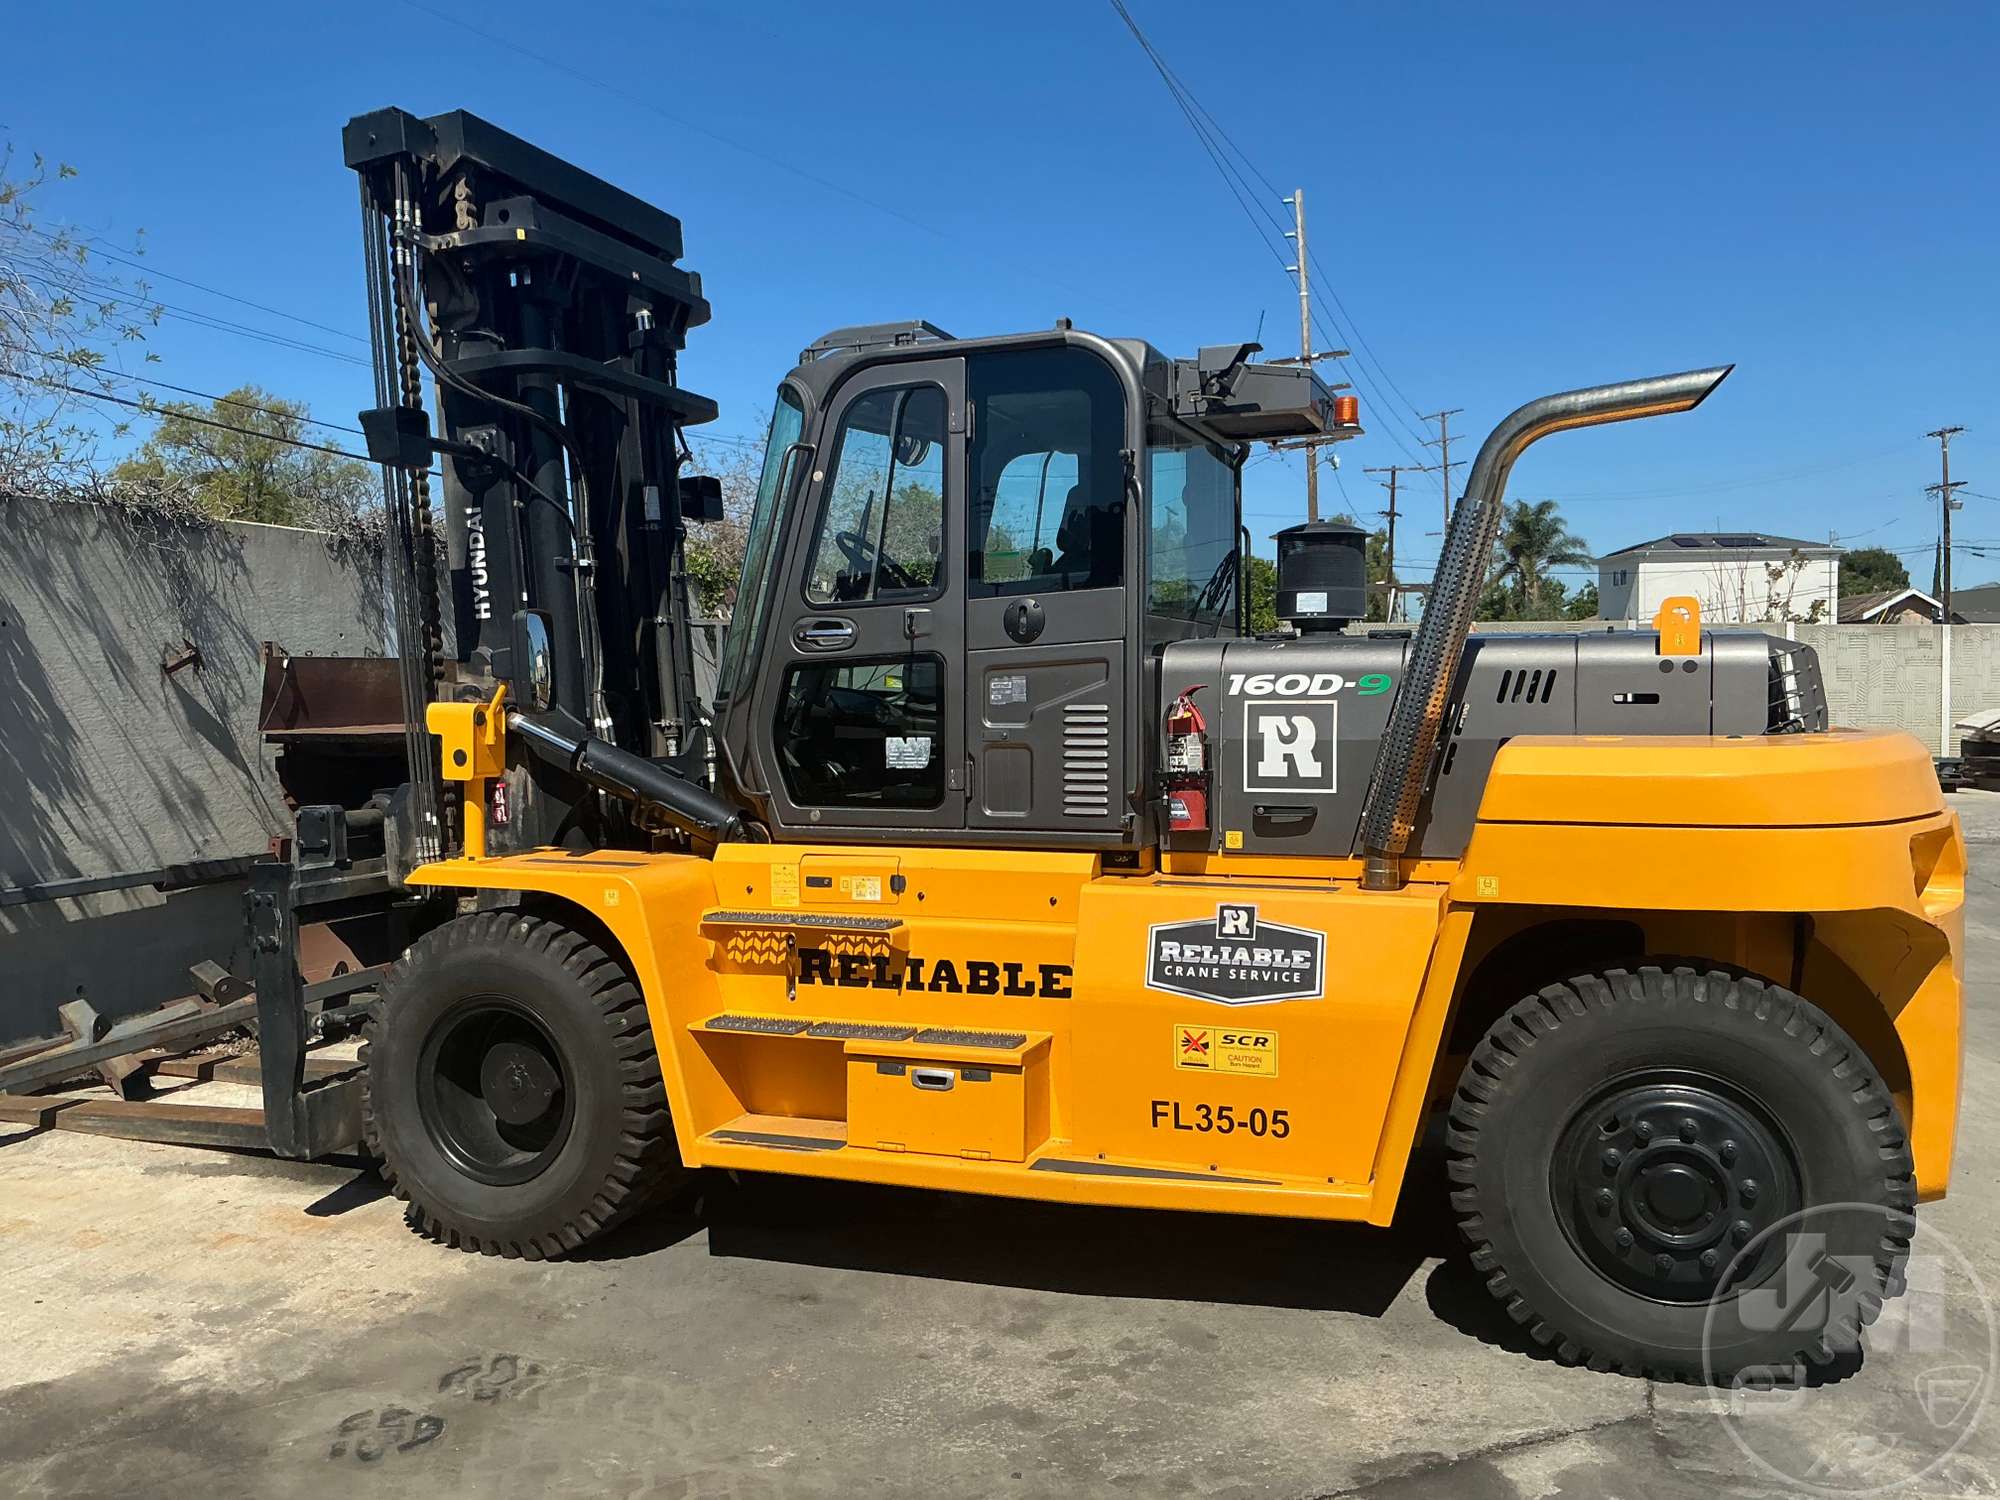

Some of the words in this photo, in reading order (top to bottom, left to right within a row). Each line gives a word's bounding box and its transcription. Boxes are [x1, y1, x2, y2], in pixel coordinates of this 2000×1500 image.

[466, 507, 491, 620] HYUNDAI
[1228, 673, 1392, 696] 160D-9
[1257, 715, 1322, 777] R
[1222, 909, 1250, 935] R
[1159, 941, 1312, 969] RELIABLE
[797, 948, 1073, 999] RELIABLE
[1164, 965, 1220, 979] CRANE
[1229, 969, 1302, 983] SERVICE
[1220, 1034, 1269, 1048] SCR
[1227, 1054, 1262, 1063] CAUTION
[1151, 1100, 1290, 1139] FL35-05
